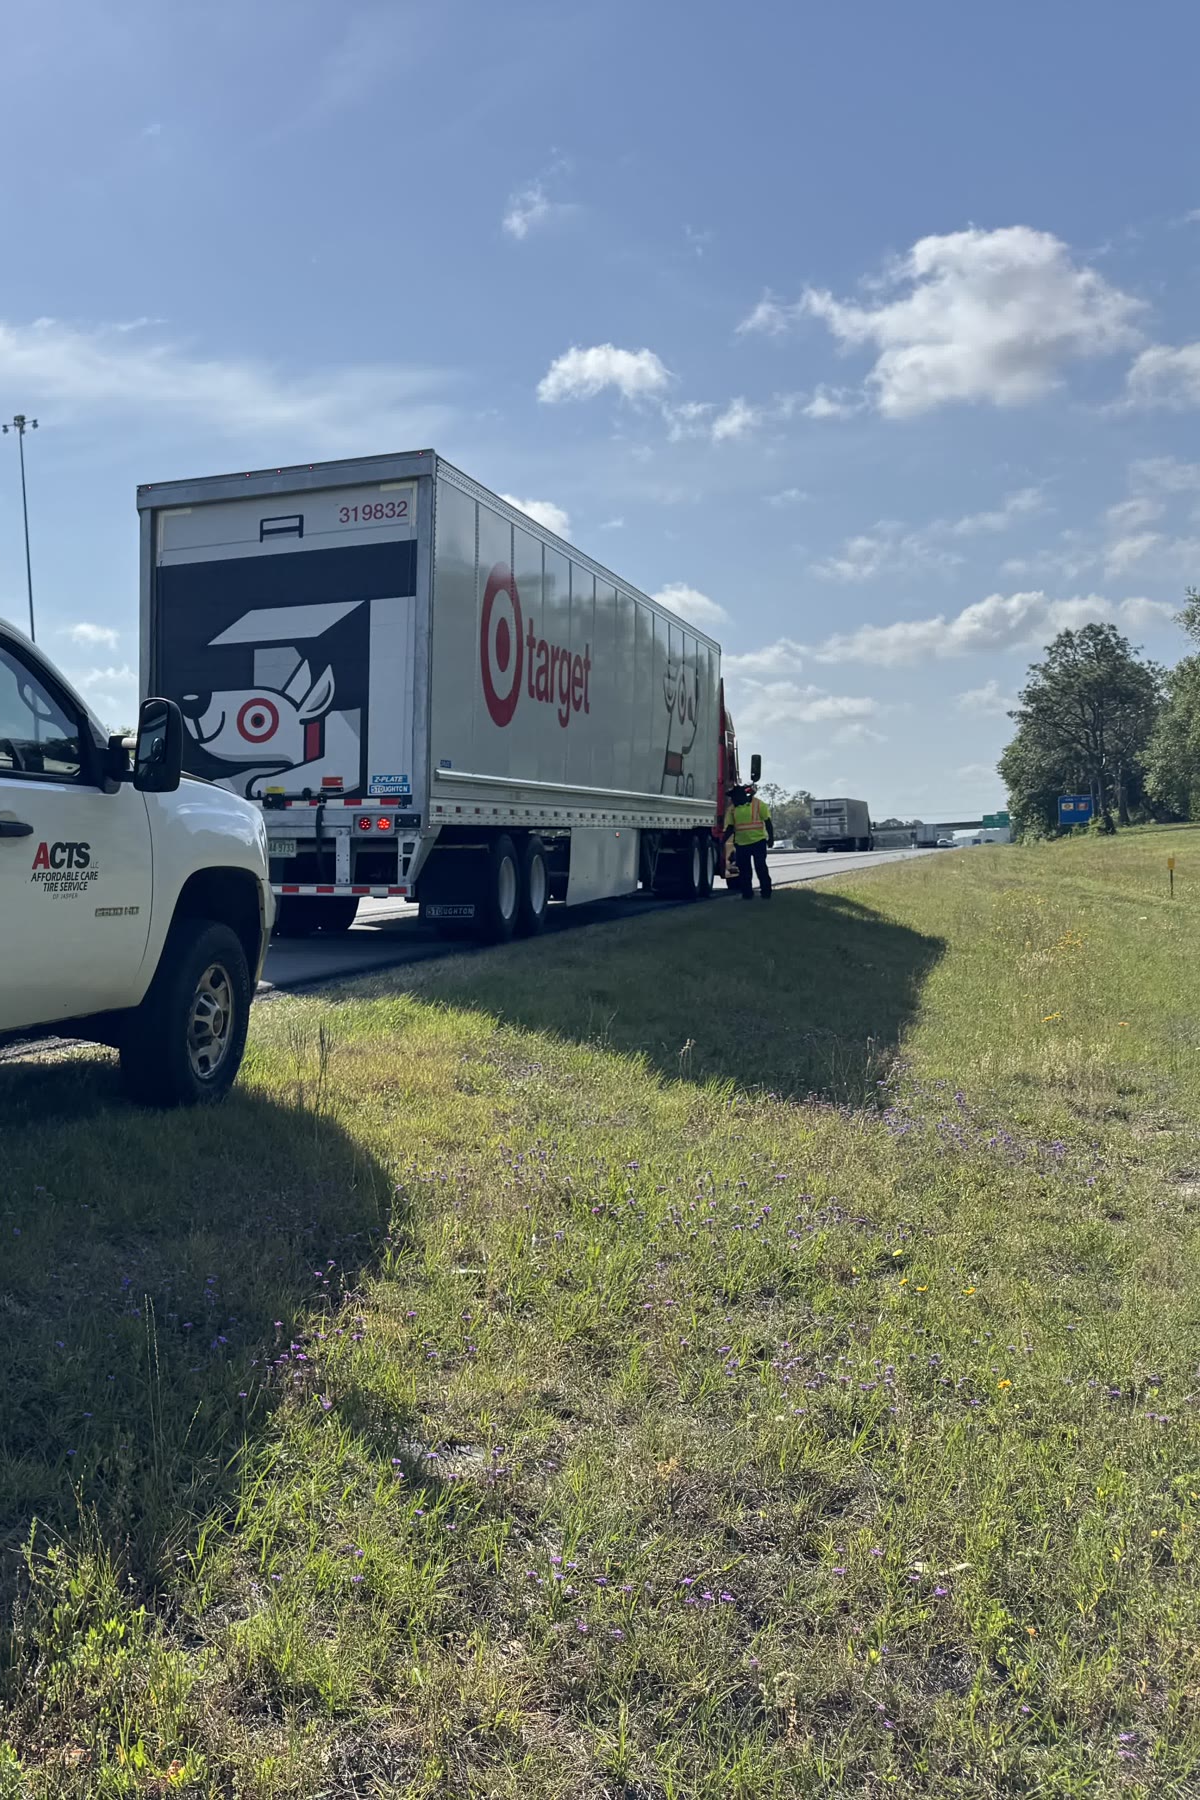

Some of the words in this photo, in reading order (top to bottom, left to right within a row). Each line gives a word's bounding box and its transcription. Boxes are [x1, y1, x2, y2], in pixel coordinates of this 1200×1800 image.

[339, 500, 408, 523] 319832
[526, 617, 591, 728] target
[374, 775, 403, 783] Z-PLATE
[370, 785, 409, 794] STOUGHTON
[31, 842, 91, 870] ACTS
[90, 860, 99, 869] LLC
[31, 872, 80, 882] AFFORDABLE
[80, 871, 99, 881] CARE
[43, 882, 59, 892] TIRE
[59, 881, 88, 891] SERVICE
